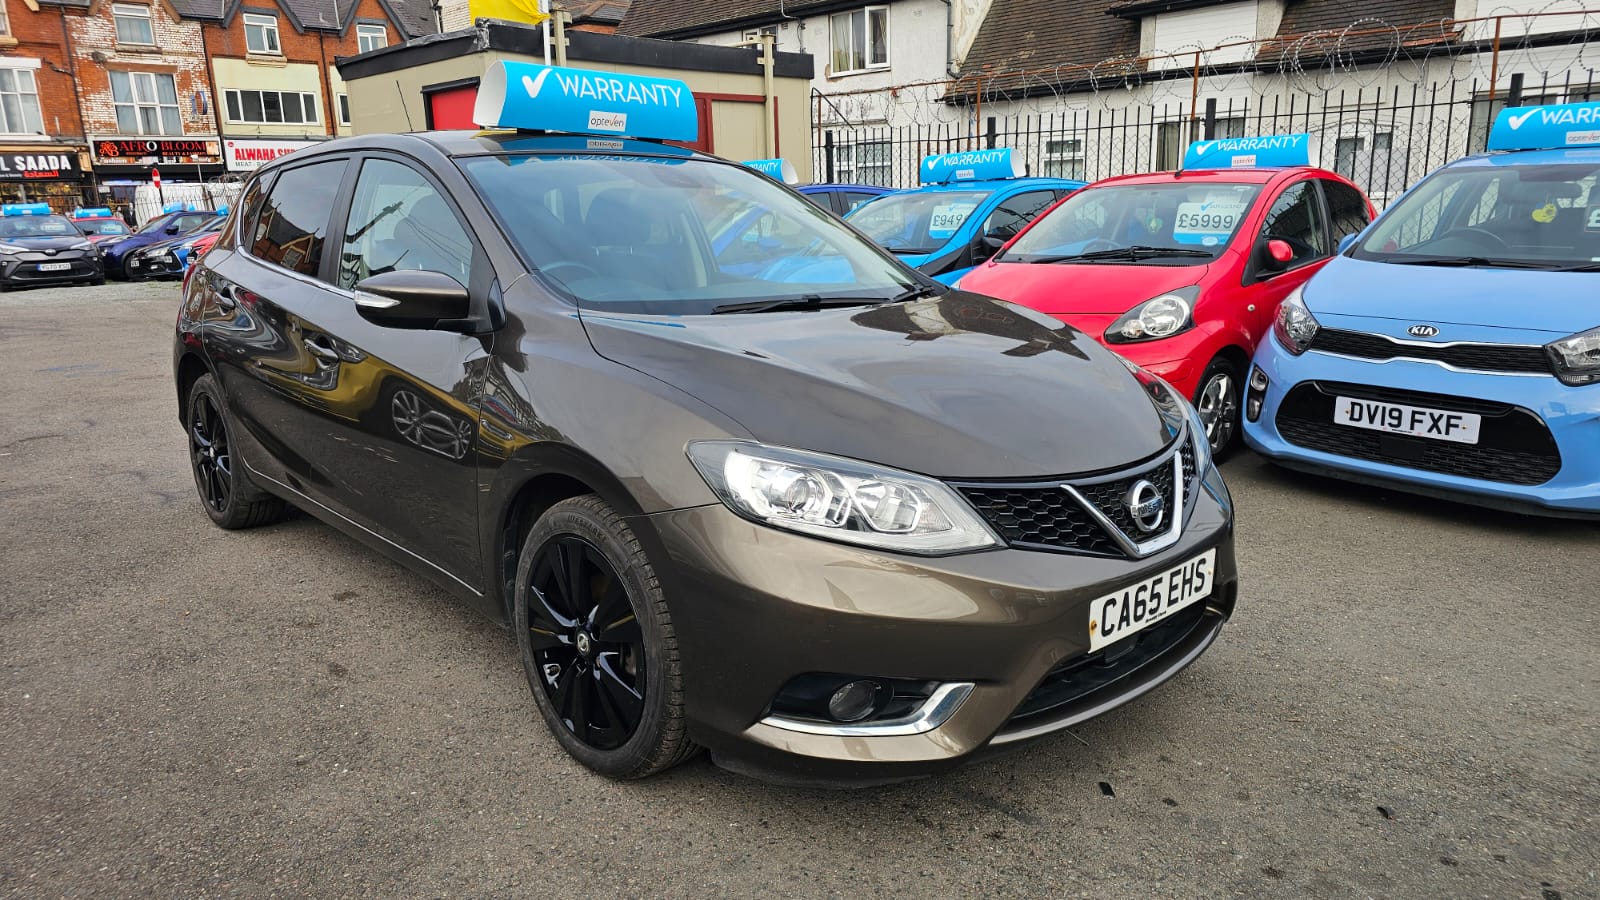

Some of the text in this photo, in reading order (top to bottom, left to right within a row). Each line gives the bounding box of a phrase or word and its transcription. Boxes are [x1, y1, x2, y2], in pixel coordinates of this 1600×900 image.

[555, 72, 681, 108] WARRANTY
[590, 115, 625, 128] opteven
[120, 141, 206, 152] AFRO BLOOM
[1217, 136, 1302, 151] WARRANTY
[235, 149, 275, 160] ALWAHA
[943, 151, 1006, 166] WARRANTY
[14, 155, 72, 171] SAADA
[933, 214, 964, 226] £949
[1178, 213, 1233, 229] £5999
[1411, 326, 1434, 335] KIA
[1349, 401, 1463, 436] DV19 FXF
[1101, 557, 1207, 637] CA65 EHS
